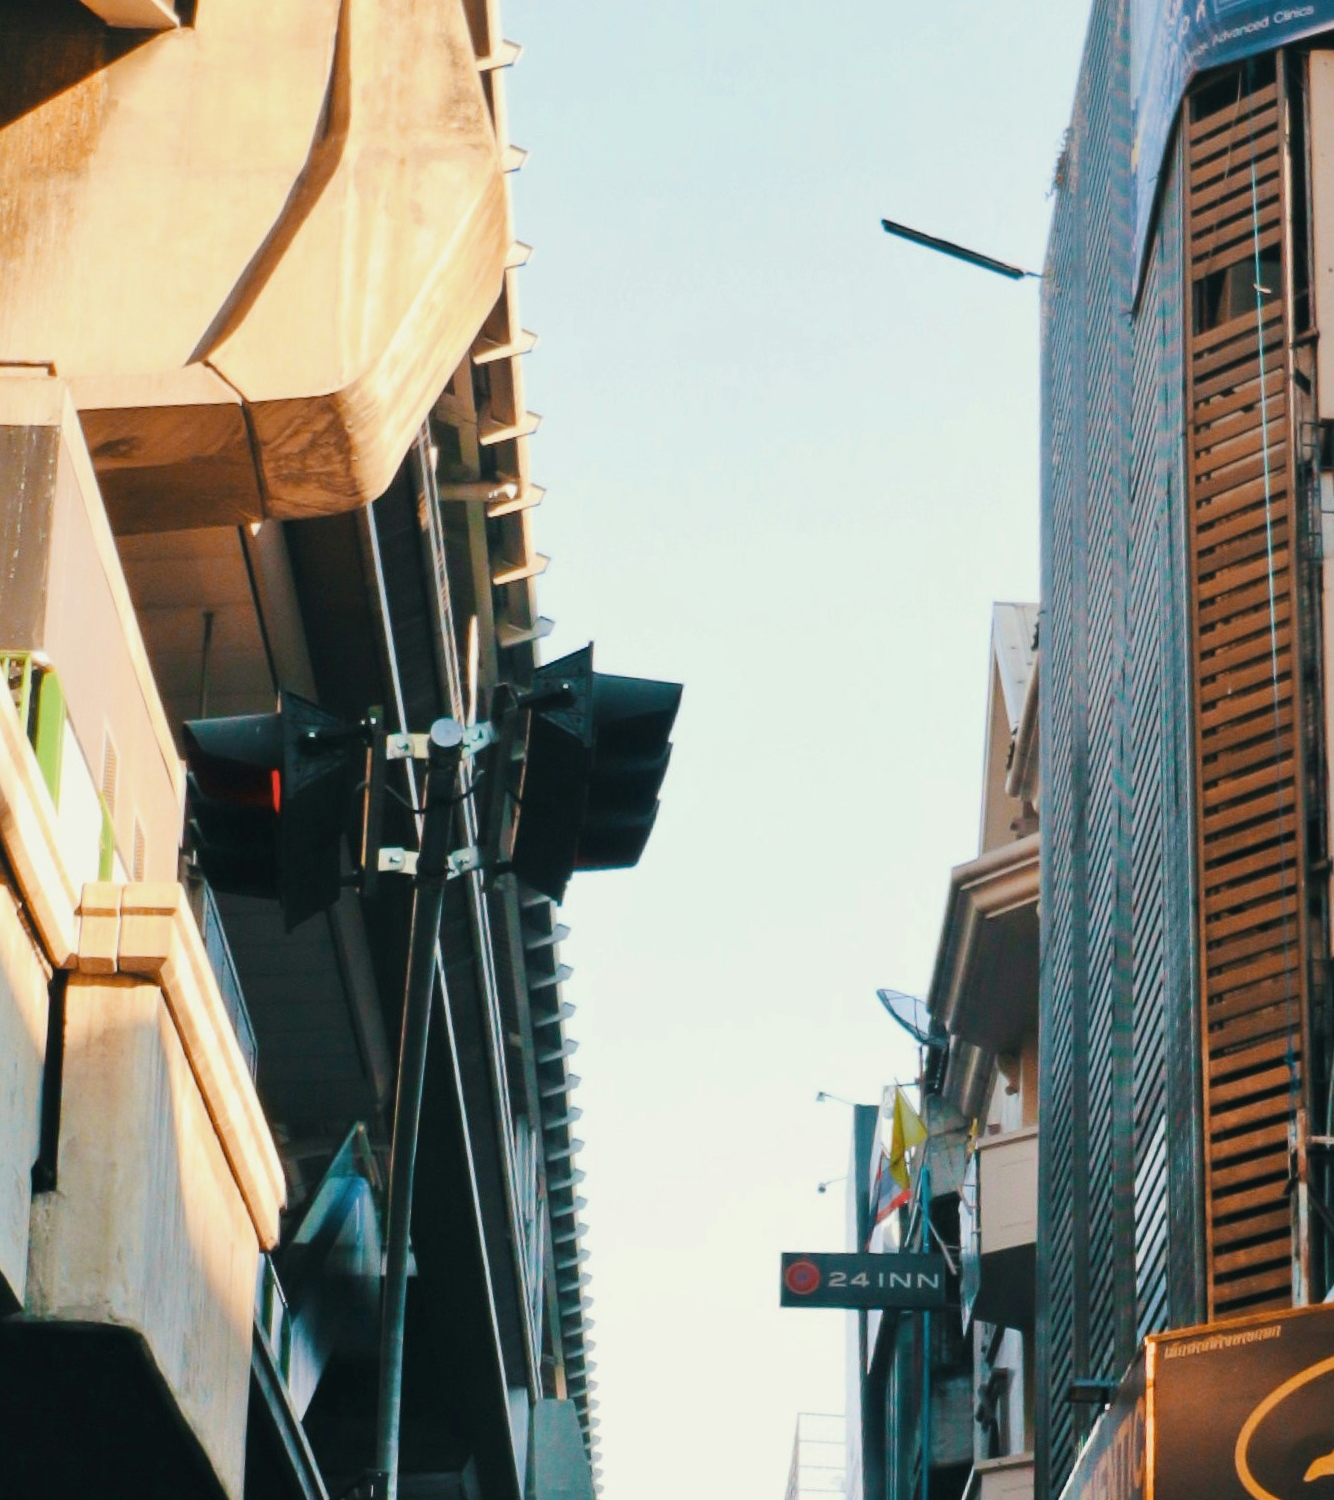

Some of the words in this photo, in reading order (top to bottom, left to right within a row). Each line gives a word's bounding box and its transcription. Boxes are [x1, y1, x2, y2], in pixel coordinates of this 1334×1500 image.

[1273, 5, 1315, 24] Clinics
[827, 1271, 870, 1288] 24
[878, 1271, 940, 1289] INN
